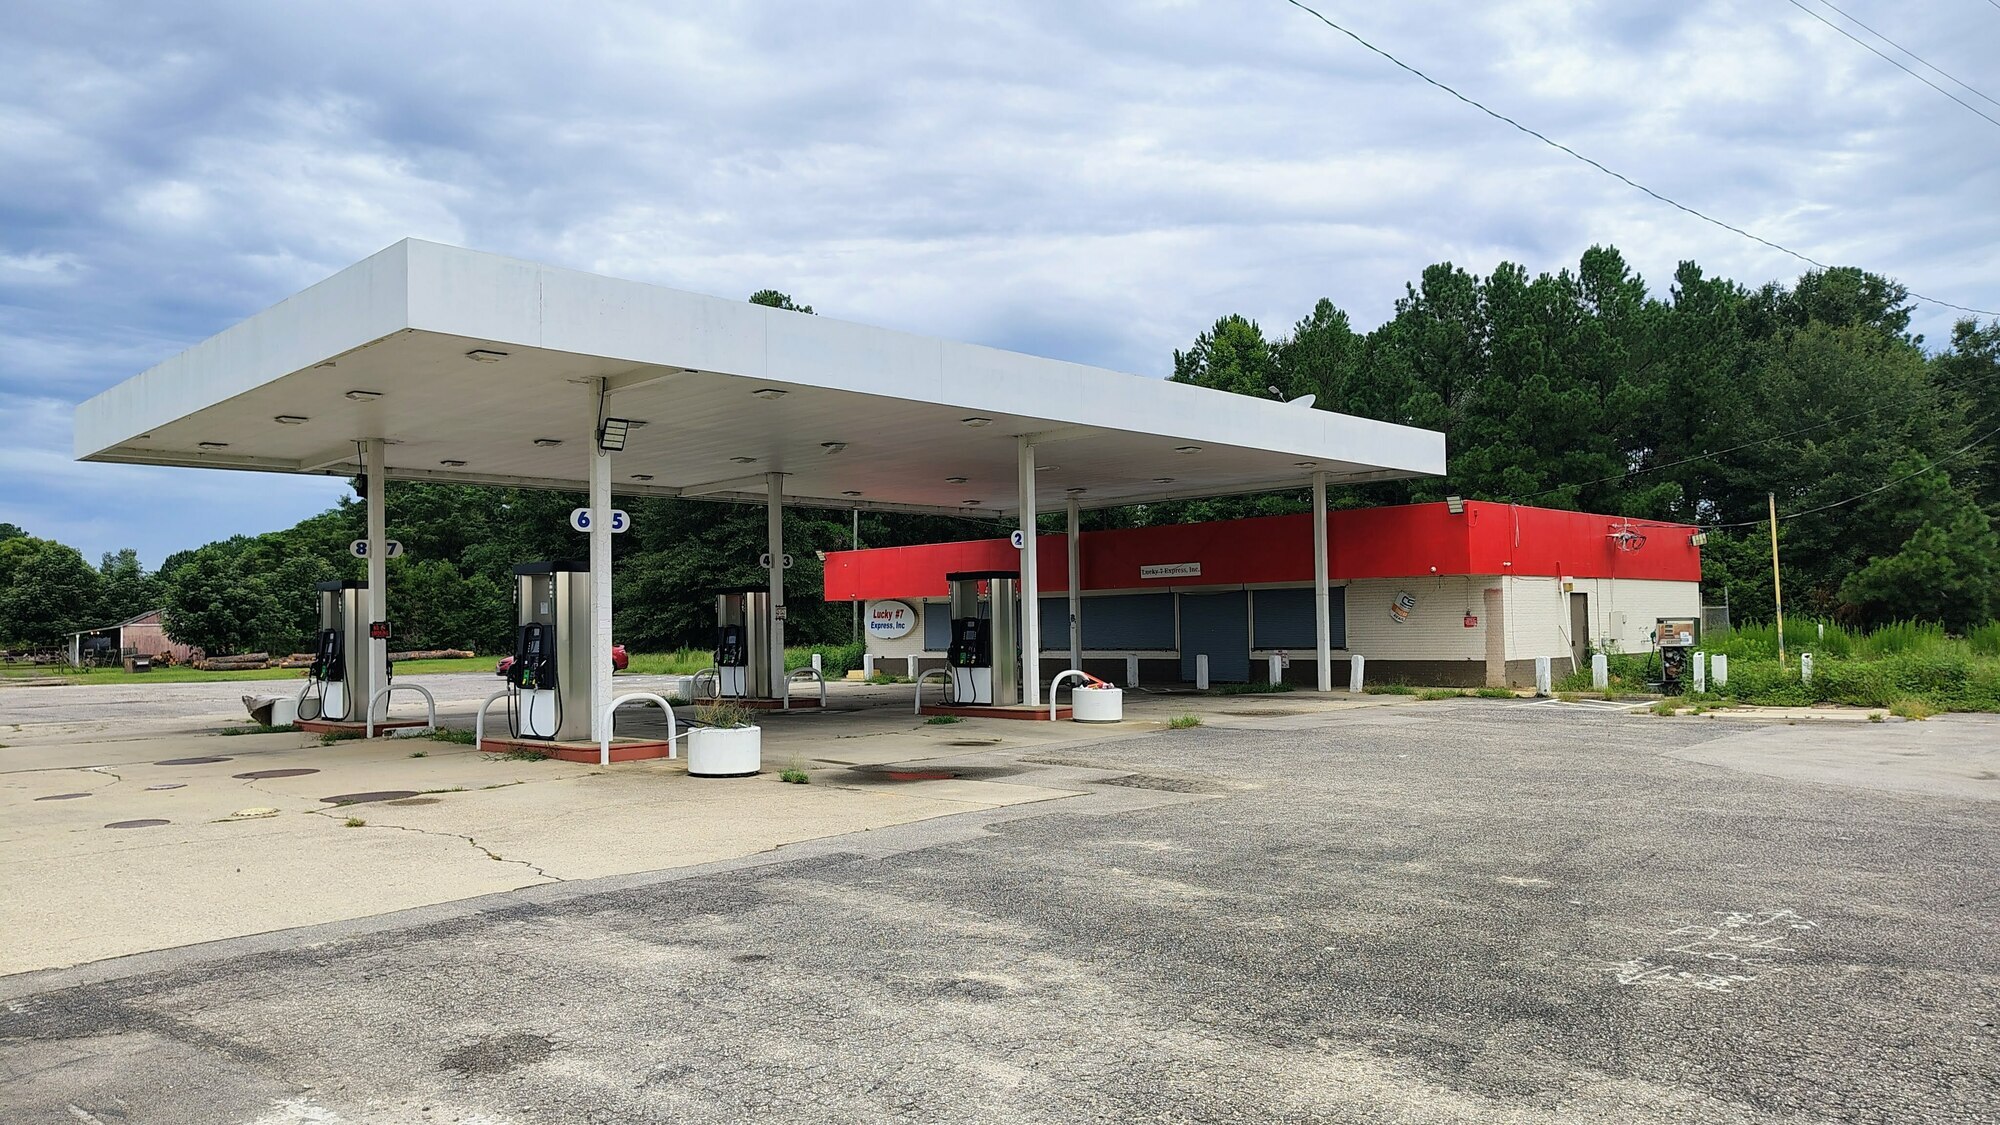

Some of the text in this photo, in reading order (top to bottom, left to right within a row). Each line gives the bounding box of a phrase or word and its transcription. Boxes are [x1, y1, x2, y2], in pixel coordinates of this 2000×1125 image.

[578, 511, 590, 528] 6
[612, 513, 623, 529] 5
[1014, 532, 1022, 545] 2
[356, 542, 367, 555] 8
[387, 542, 397, 555] 7
[763, 555, 771, 566] 4
[783, 555, 790, 566] 3
[873, 609, 904, 621] Lucky #7
[896, 621, 905, 629] Inc
